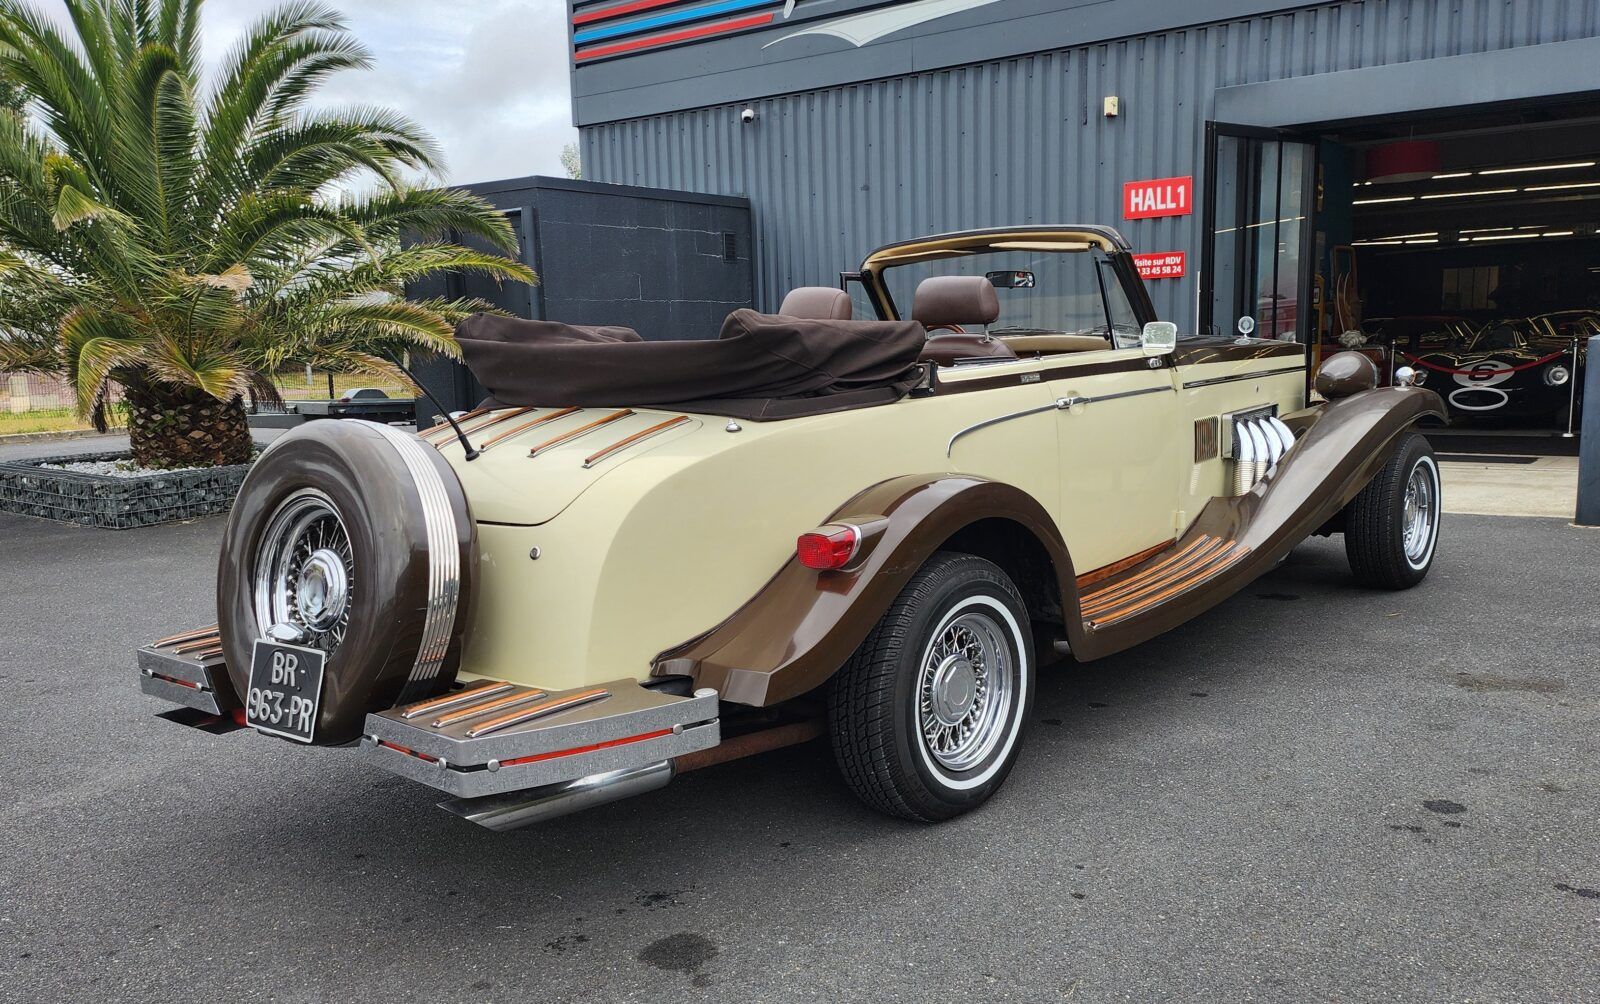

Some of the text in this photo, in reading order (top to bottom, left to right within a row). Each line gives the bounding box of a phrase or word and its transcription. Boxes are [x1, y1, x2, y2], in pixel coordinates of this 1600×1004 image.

[1165, 256, 1182, 265] RDV
[1141, 267, 1150, 275] 33
[1151, 266, 1161, 274] 45
[1162, 265, 1171, 273] 58
[1172, 264, 1182, 272] 24
[248, 687, 314, 733] 963-PR
